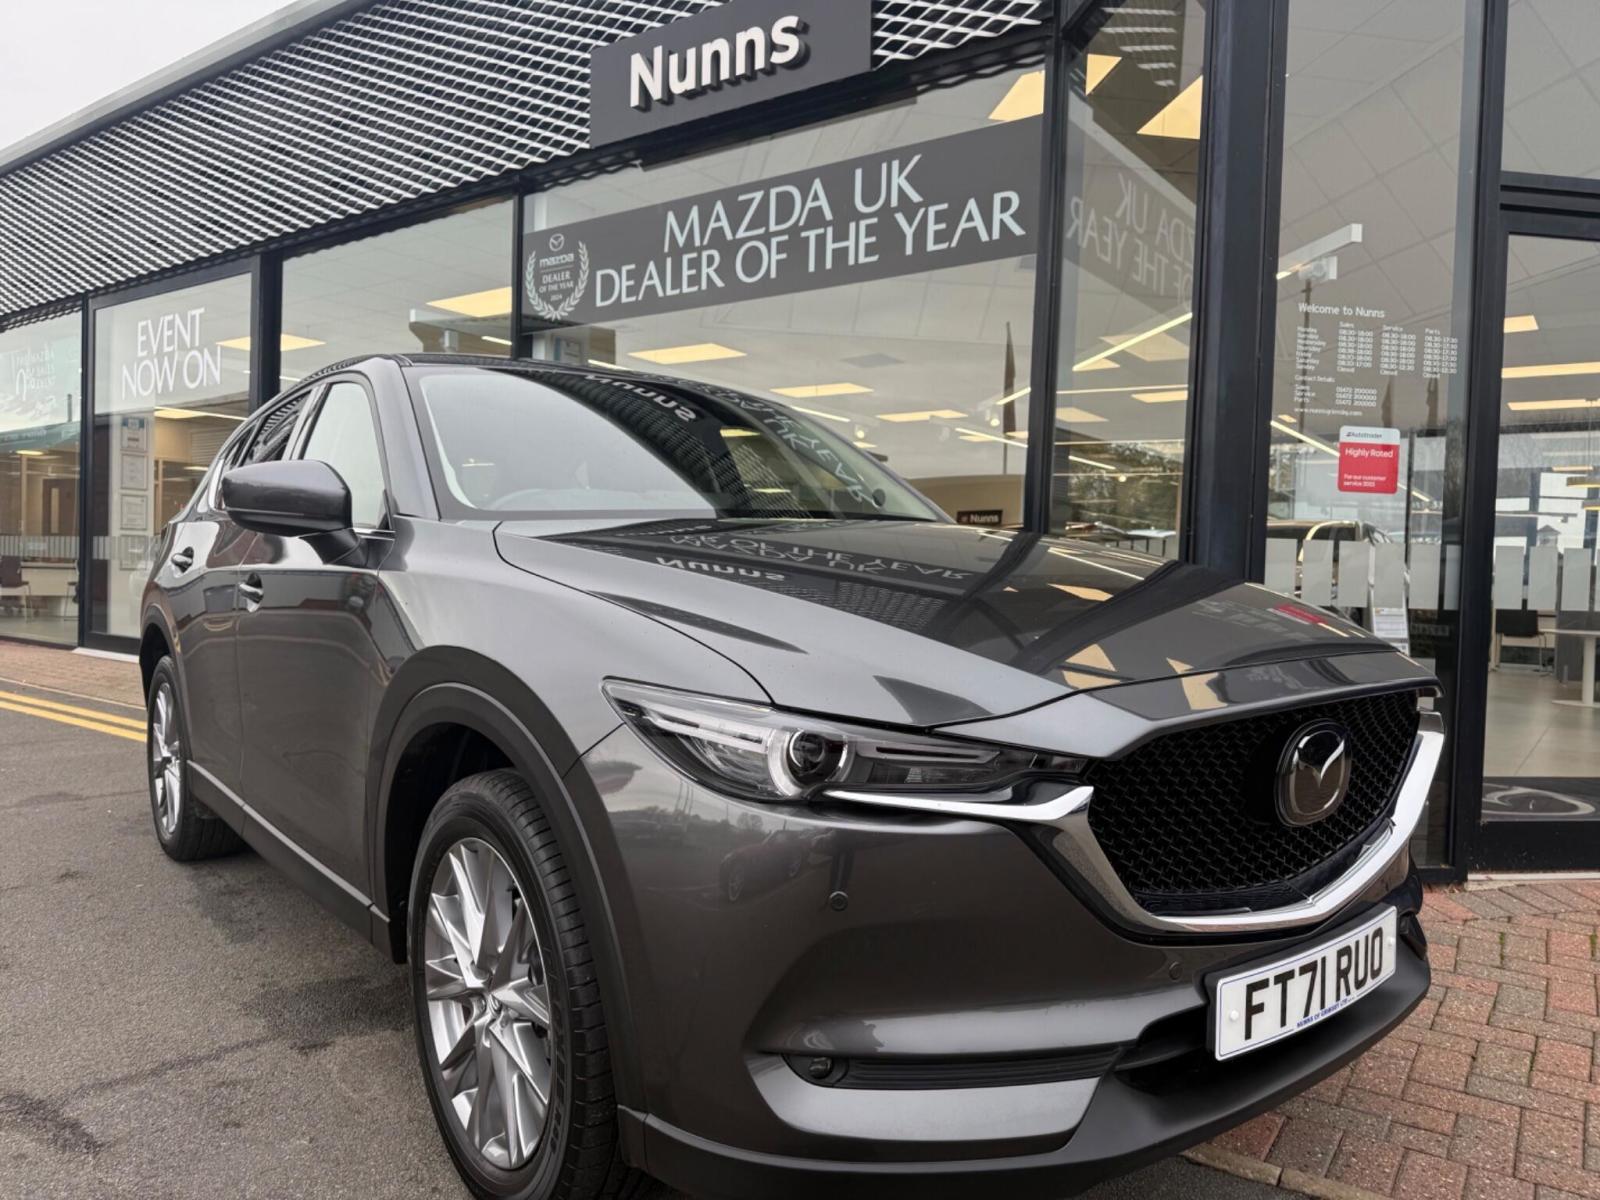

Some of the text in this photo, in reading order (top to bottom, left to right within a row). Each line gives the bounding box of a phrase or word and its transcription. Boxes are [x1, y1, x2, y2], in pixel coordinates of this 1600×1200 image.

[629, 15, 804, 110] Nunns
[663, 153, 925, 253] MAZDA UK
[595, 190, 1026, 308] DEALER OF THE YEAR
[539, 280, 574, 294] OF THE YEAR
[542, 270, 571, 285] DEALER
[137, 307, 205, 358] EVENT
[1298, 302, 1385, 318] Welcome to Nunns
[121, 345, 221, 401] NOW ON
[1345, 448, 1394, 458] Highly Rated
[1245, 927, 1383, 1041] FT71 RUO
